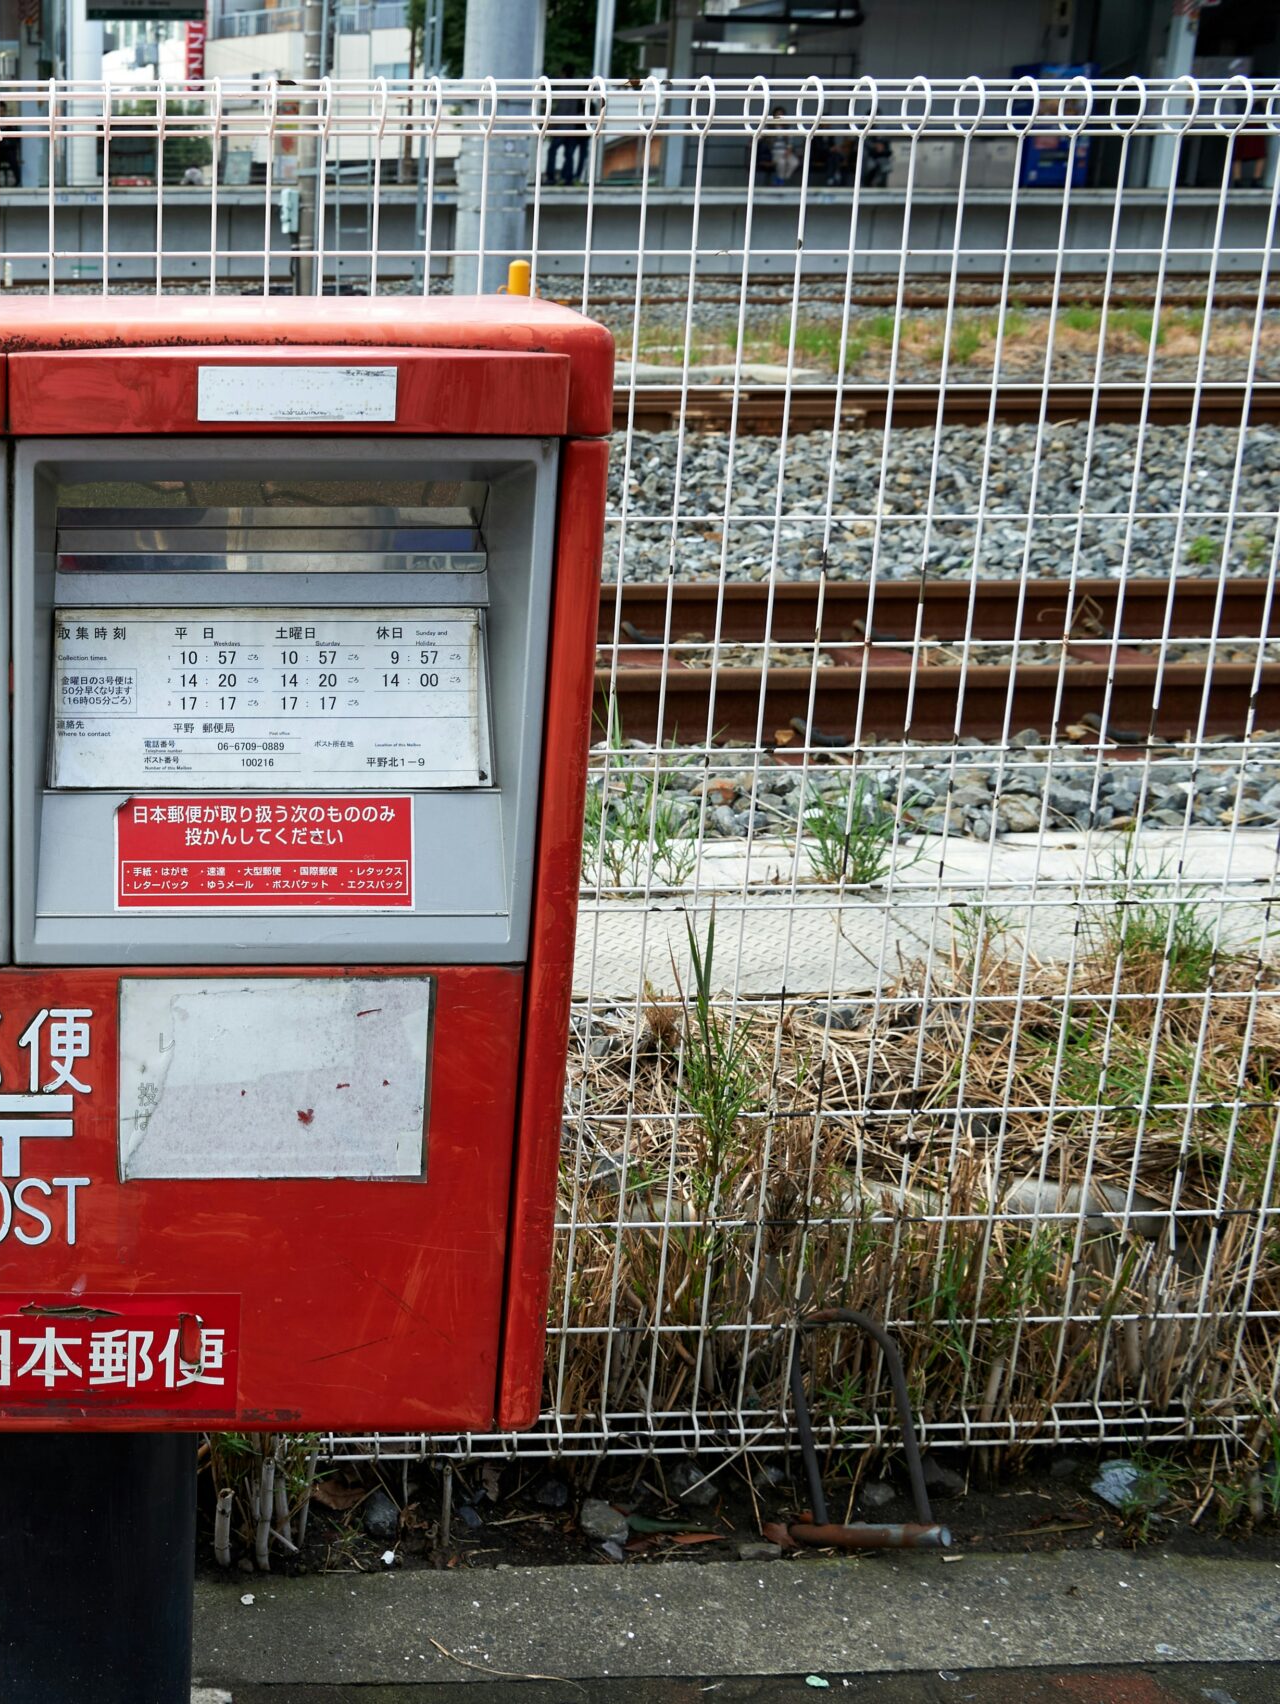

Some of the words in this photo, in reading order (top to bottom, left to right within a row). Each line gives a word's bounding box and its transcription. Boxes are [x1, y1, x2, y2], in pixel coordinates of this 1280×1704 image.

[276, 627, 316, 639] 土曜日
[376, 626, 403, 639] 休日
[61, 676, 134, 685] 金曜日の3号便は
[61, 686, 132, 695] 50分早くなります
[173, 723, 195, 733] 平野
[202, 723, 235, 733] 郵便局
[143, 740, 175, 749] 電話番号
[217, 742, 285, 751] 06-6709-0889
[314, 740, 355, 748] ポスト所在地
[143, 756, 180, 764] ポスト番号
[241, 758, 275, 767] 100216
[134, 805, 396, 824] 日本郵便が取り扱う次のもののみ
[185, 827, 344, 846] 投かんしてください
